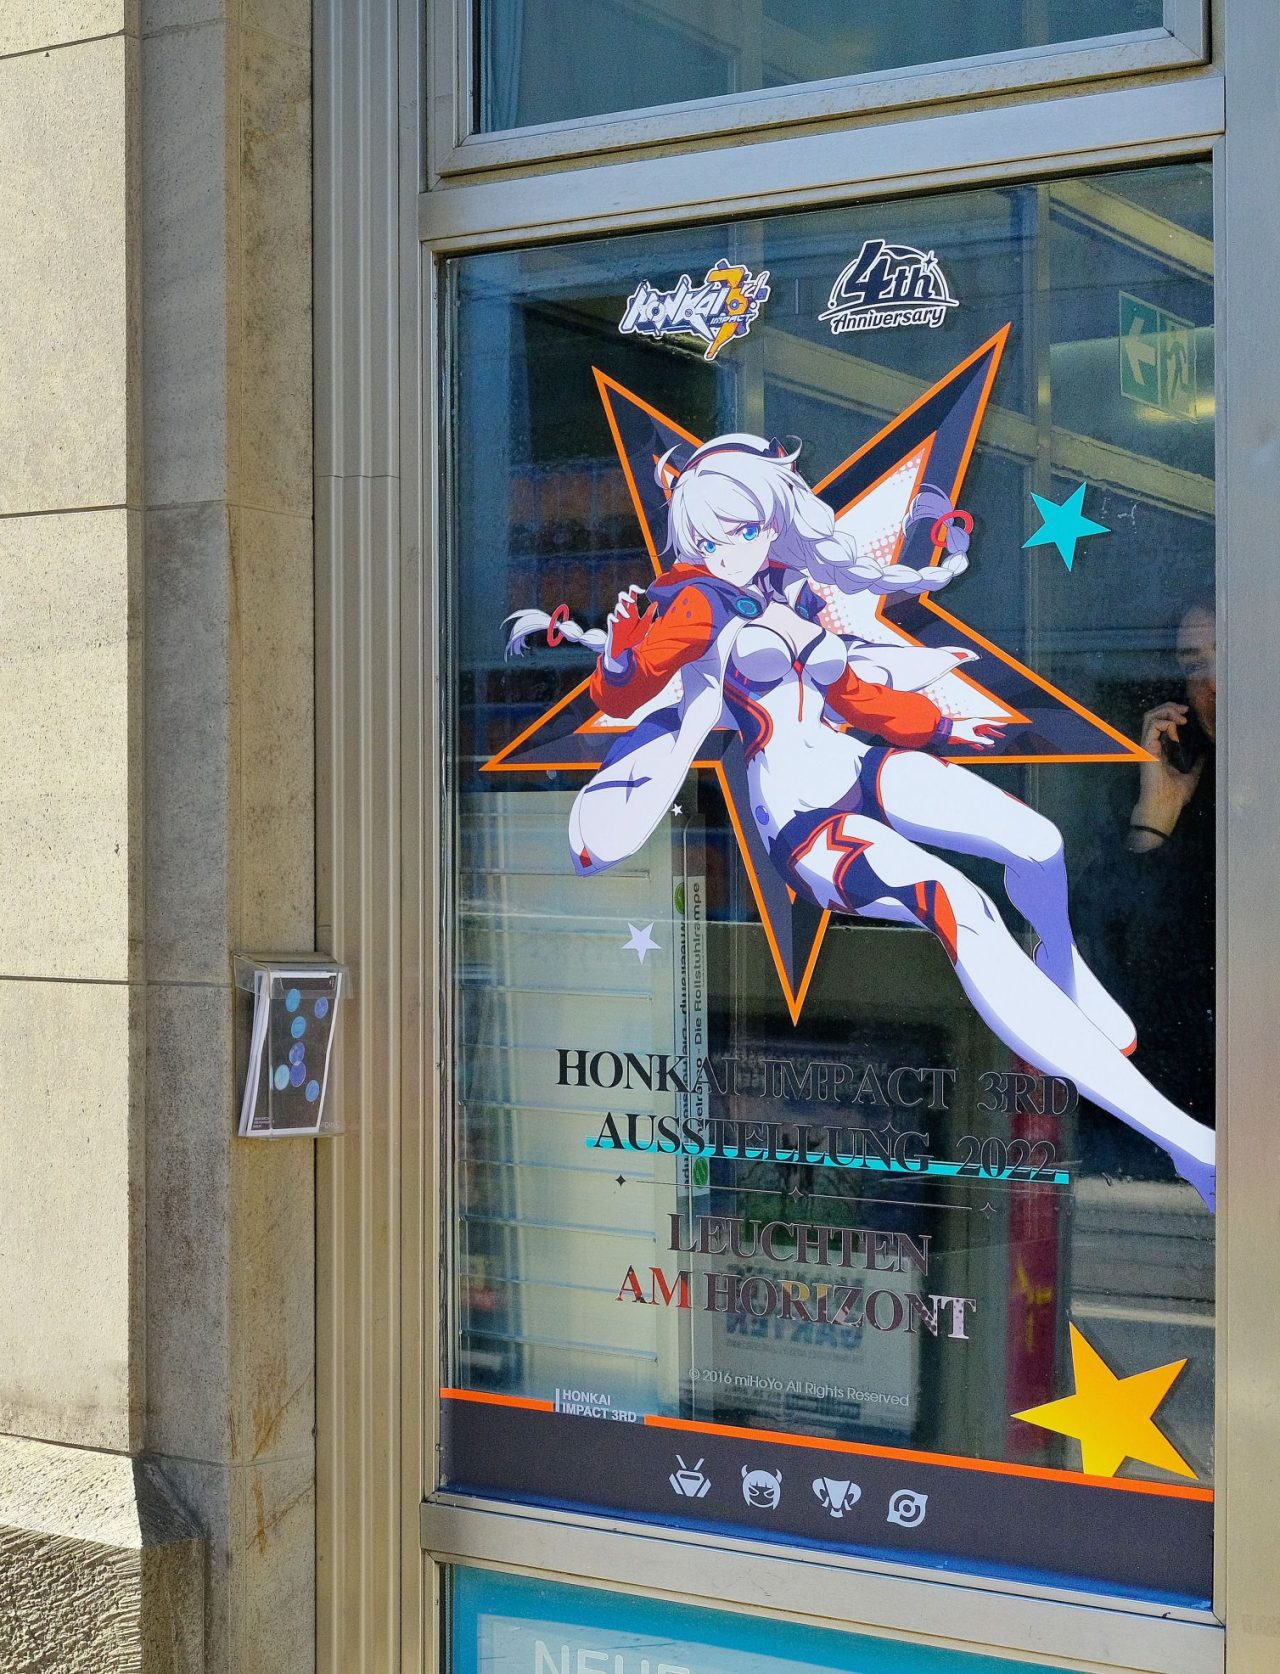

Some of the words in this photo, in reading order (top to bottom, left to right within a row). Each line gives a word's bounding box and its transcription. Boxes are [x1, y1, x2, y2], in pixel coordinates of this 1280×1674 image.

[844, 240, 936, 302] 4th
[833, 306, 945, 334] Anniversary
[692, 882, 703, 1012] Rollstuhlrampe
[694, 1018, 702, 1045] Die
[555, 1049, 740, 1096] HONKAI
[760, 1059, 956, 1109] IMPACT
[976, 1071, 1079, 1115] 3RD
[593, 1112, 934, 1173] AUSSTELLUNG
[956, 1135, 1056, 1181] 2022
[667, 1213, 932, 1276] LEUCHTEN
[615, 1265, 692, 1308] AM
[703, 1272, 977, 1339] HORIZONT
[562, 1402, 609, 1419] IMPACT
[611, 1410, 637, 1422] 3RD
[563, 1389, 611, 1405] HONKAI
[702, 1370, 732, 1385] 2016
[734, 1374, 783, 1391] miHoYo
[786, 1381, 802, 1393] All
[805, 1383, 844, 1399] Rights
[847, 1387, 909, 1407] Reserved
